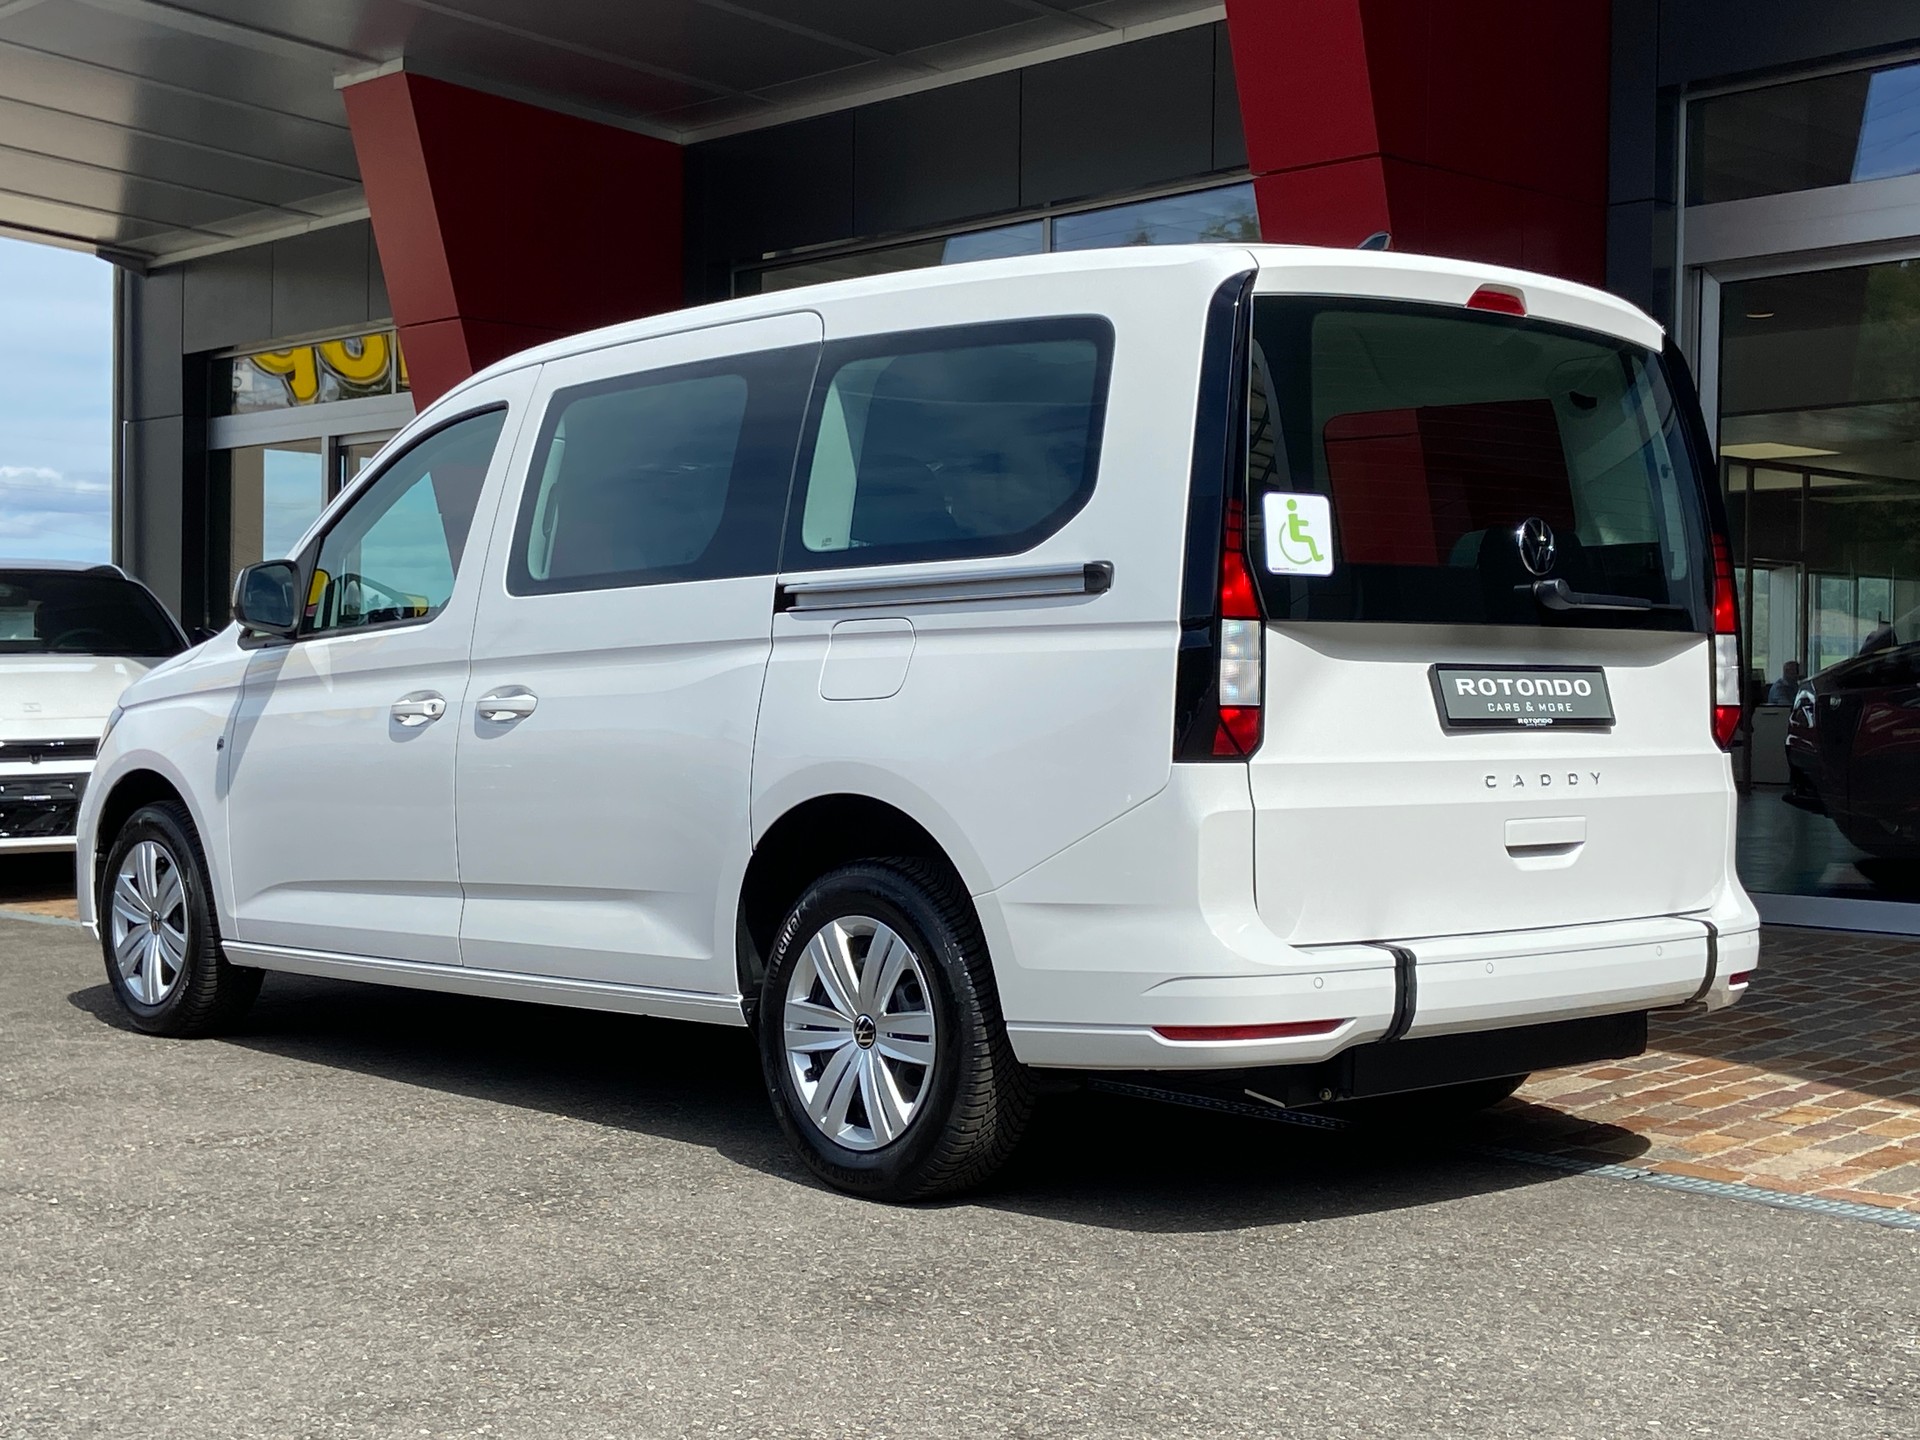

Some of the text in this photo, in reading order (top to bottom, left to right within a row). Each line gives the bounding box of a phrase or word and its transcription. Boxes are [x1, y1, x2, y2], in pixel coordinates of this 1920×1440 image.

[1455, 679, 1592, 696] ROTONDO
[1488, 702, 1574, 712] CARS & MORE
[1485, 772, 1601, 788] CADDY
